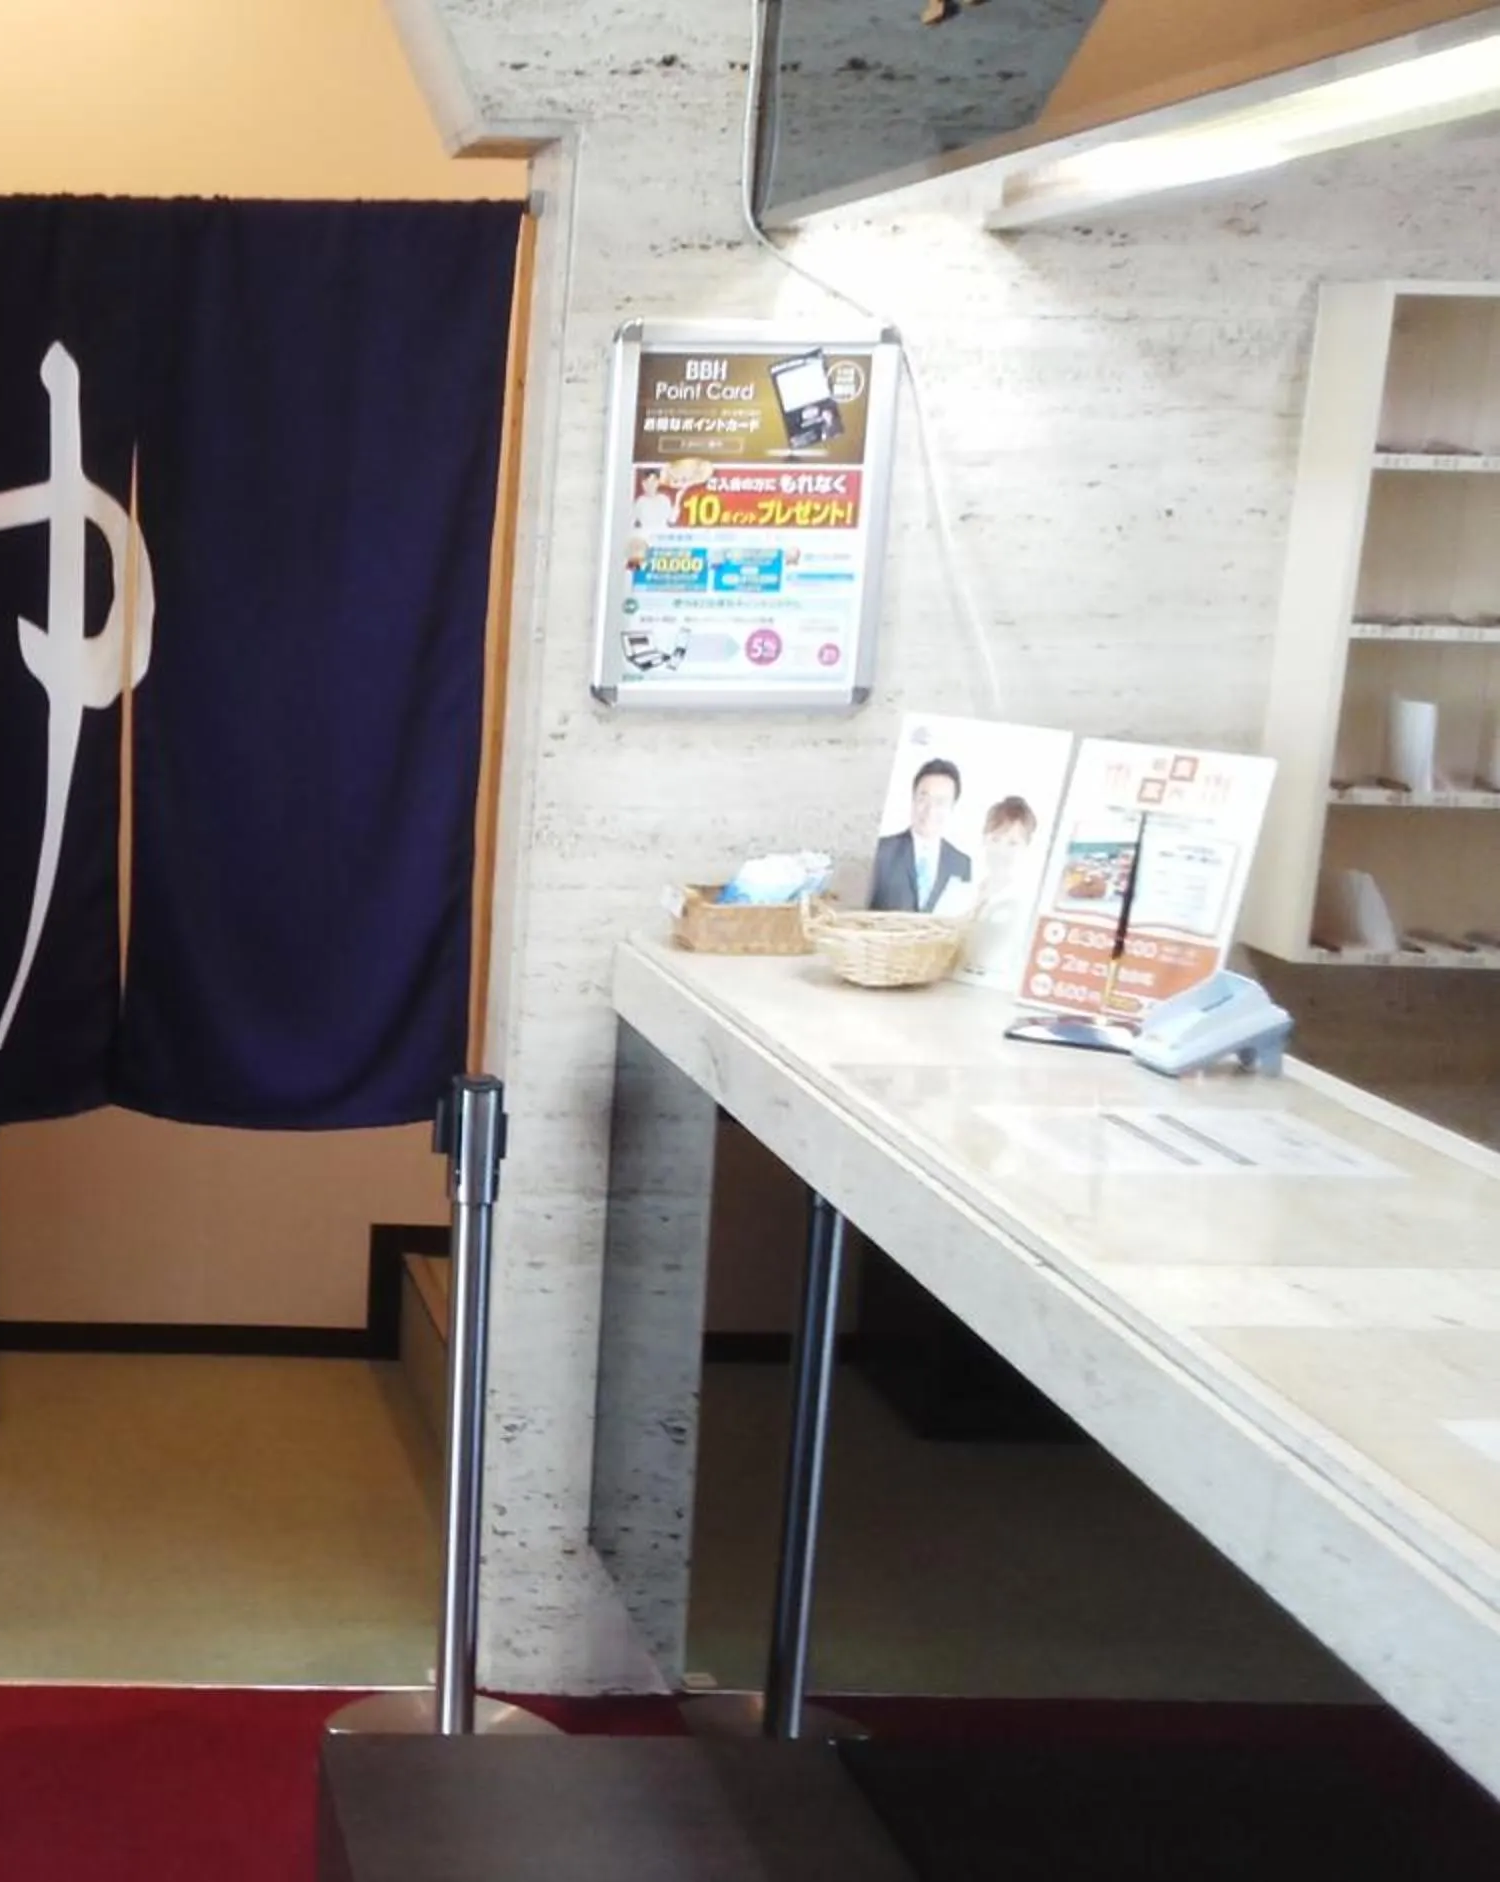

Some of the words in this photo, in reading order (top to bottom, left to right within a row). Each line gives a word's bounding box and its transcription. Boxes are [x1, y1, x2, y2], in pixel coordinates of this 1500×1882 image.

[686, 359, 728, 381] BBH
[655, 381, 700, 400] Point
[706, 381, 754, 400] Card
[780, 474, 847, 494] もれなく
